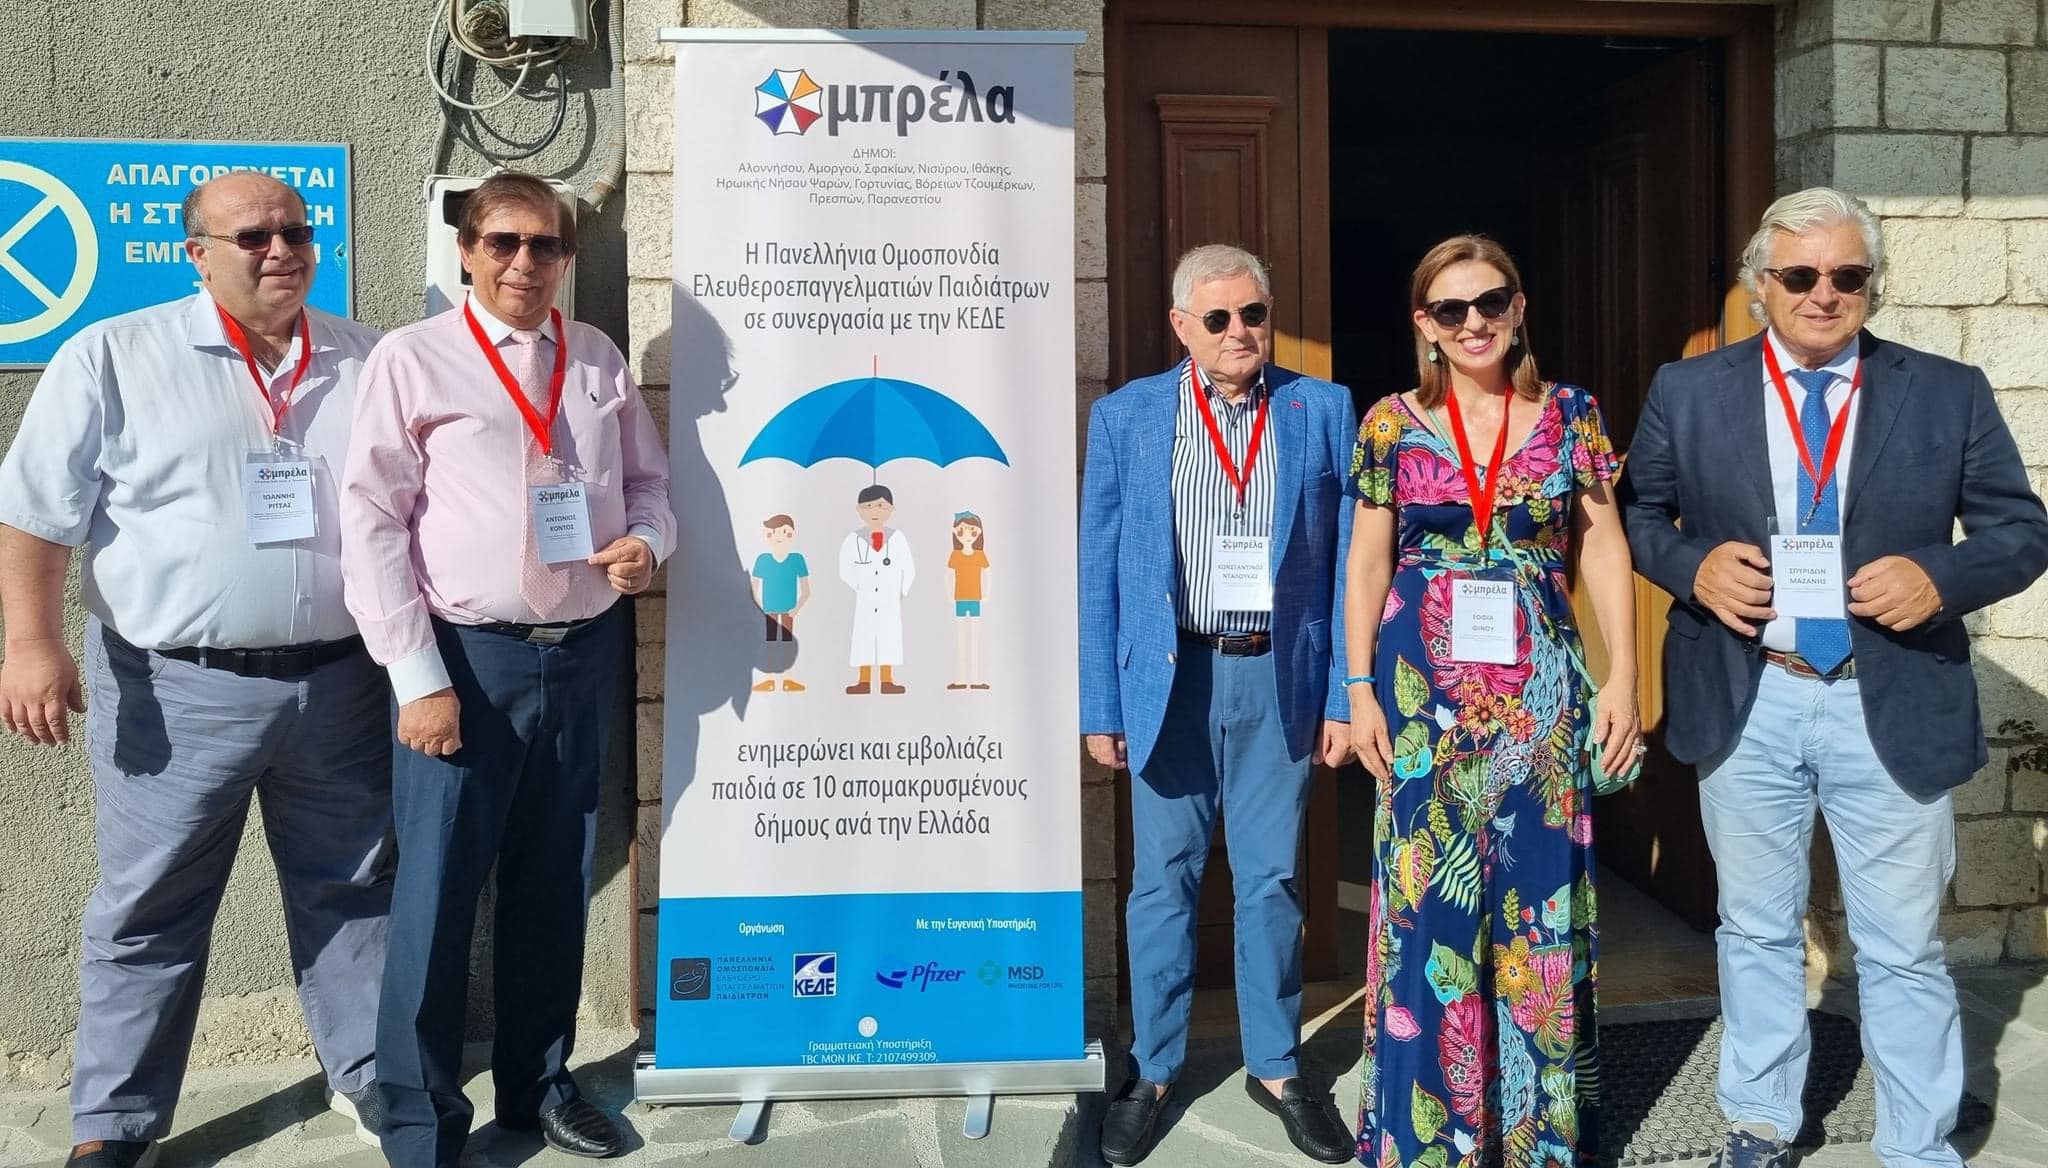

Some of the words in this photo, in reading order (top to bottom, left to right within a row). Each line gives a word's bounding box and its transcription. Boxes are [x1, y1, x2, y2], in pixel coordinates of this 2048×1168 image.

[853, 149, 896, 159] ΔΗΜΟΙ:
[107, 163, 335, 188] ΑΠΑΓΟΡΕΤΑΙ
[738, 163, 805, 175] Αλοννήσου,
[808, 163, 862, 175] Αμοργού,
[864, 163, 915, 175] Σφακίων,
[918, 163, 969, 176] Νισύρου,
[972, 163, 1011, 176] Ιθάκης,
[716, 178, 766, 190] Ηρωικής
[768, 178, 807, 190] Νήσου
[810, 178, 851, 190] Ψαρών,
[855, 178, 912, 190] Γορτυνίας,
[916, 178, 962, 191] Βόρειων
[964, 177, 1036, 192] Τζουμέρκων,
[809, 192, 865, 206] Πρεσπών,
[868, 193, 942, 206] Παρανεστίου
[746, 242, 758, 265] Η
[766, 241, 877, 271] Πανελλήνια
[882, 241, 1000, 271] Ομοσπονδία
[693, 274, 933, 303] Ελευθεροεπαγγελματιών
[939, 274, 1050, 304] Παιδιάτρων
[744, 312, 766, 330] σε
[772, 307, 884, 335] συνεργασία
[890, 312, 913, 336] με
[918, 312, 951, 336] την
[957, 307, 1005, 329] ΚΕΔΕ
[738, 737, 854, 768] ενημερώνει
[860, 740, 890, 761] και
[896, 735, 1003, 767] εμβολιάζει
[711, 776, 776, 800] παιδιά
[782, 781, 806, 800] σε
[813, 776, 836, 799] 10
[842, 773, 1028, 803] απομακρυσμένους
[754, 813, 829, 843] δήμους
[835, 811, 872, 836] ανά
[877, 816, 912, 841] την
[919, 810, 990, 834] Ελλάδα
[739, 922, 785, 936] Οργάνωση
[916, 918, 929, 930] Με
[931, 920, 946, 932] την
[947, 918, 985, 931] Ευγενική
[986, 918, 1037, 931] Υποστήριξη
[717, 956, 773, 964] ΠΑΝΕΛΛΗΝΙΑ
[716, 965, 776, 973] ΟΜΟΣΠΟΝΔΙΑ
[1007, 966, 1044, 980] MSD
[911, 961, 966, 993] Pfizer
[794, 977, 835, 996] ΚΕΔΕ
[716, 993, 769, 1001] ΠΑΙΔΙΑΤΡΩΝ
[808, 1039, 874, 1053] Γραμματειακή
[876, 1038, 932, 1051] Υποστήριξη
[801, 1053, 820, 1065] TBC
